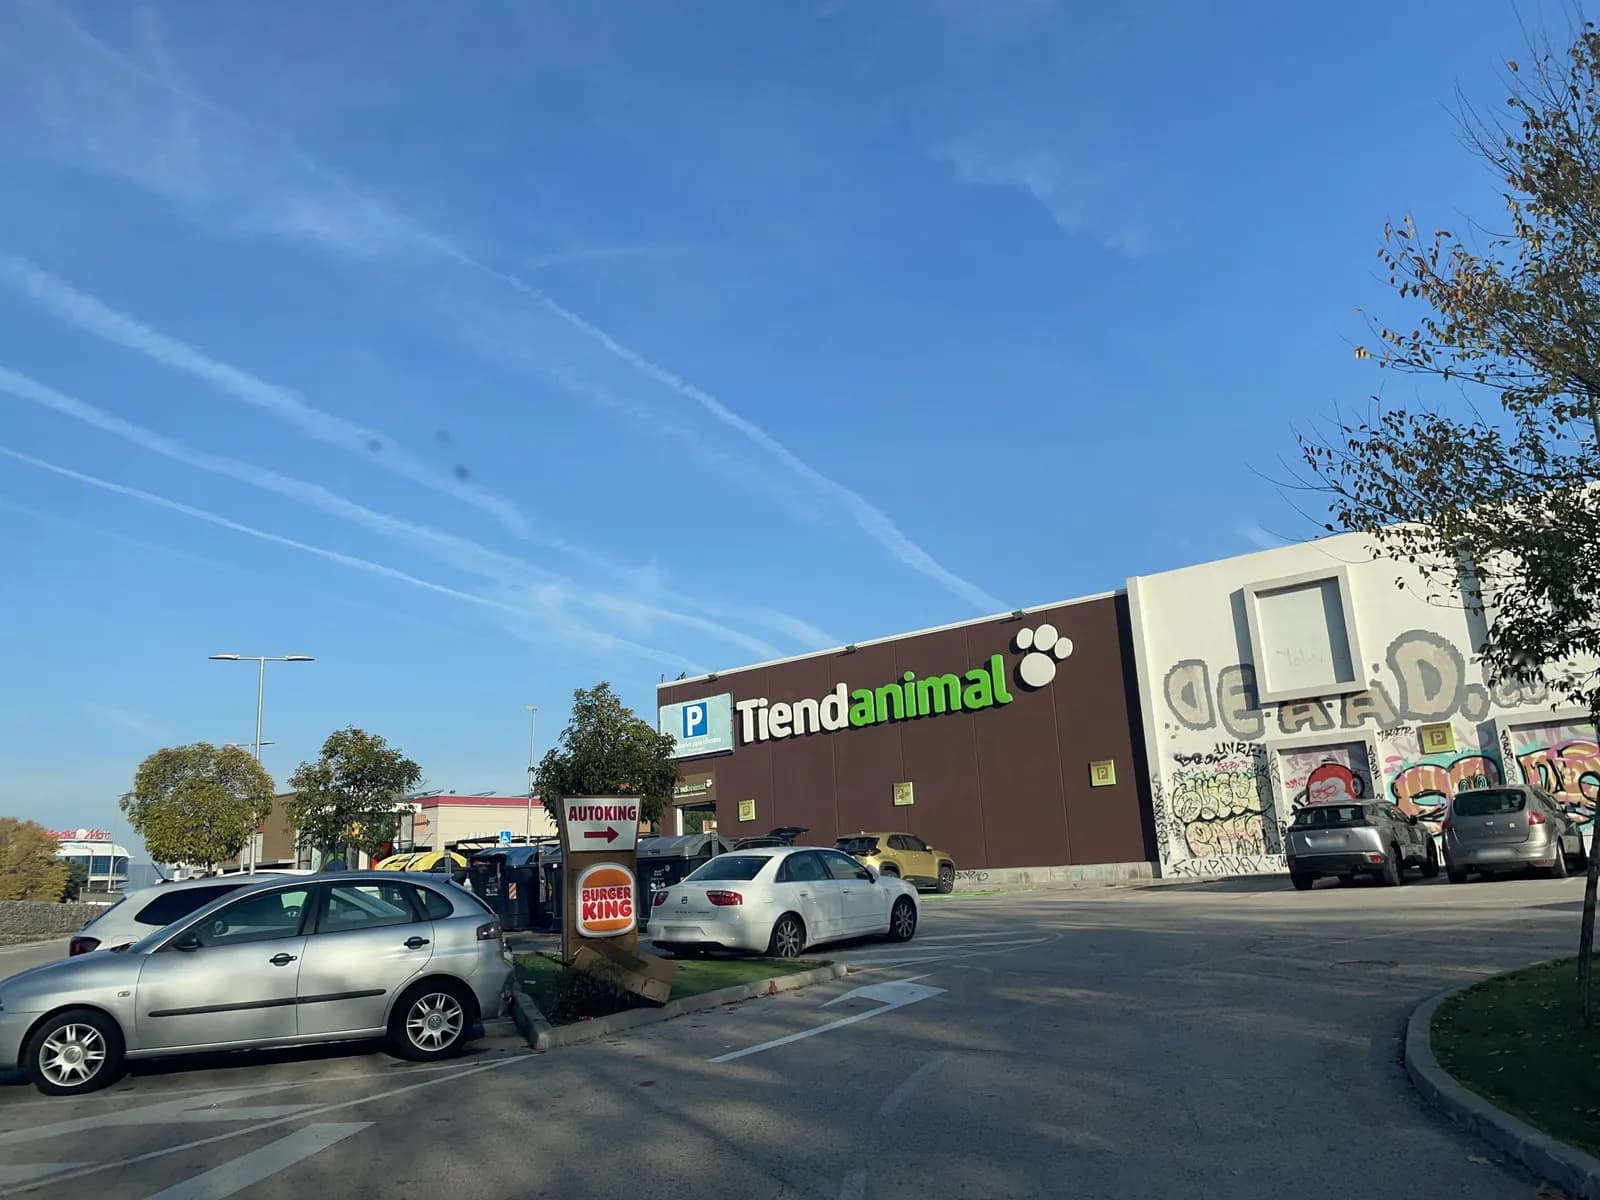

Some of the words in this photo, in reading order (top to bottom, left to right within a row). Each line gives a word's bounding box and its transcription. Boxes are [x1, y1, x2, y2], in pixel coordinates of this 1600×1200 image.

[736, 654, 1014, 744] Tiendanimal
[686, 705, 703, 737] P
[1432, 731, 1444, 745] P
[568, 806, 637, 821] AUTOKING
[582, 886, 632, 902] BURGER
[582, 900, 633, 921] KING
